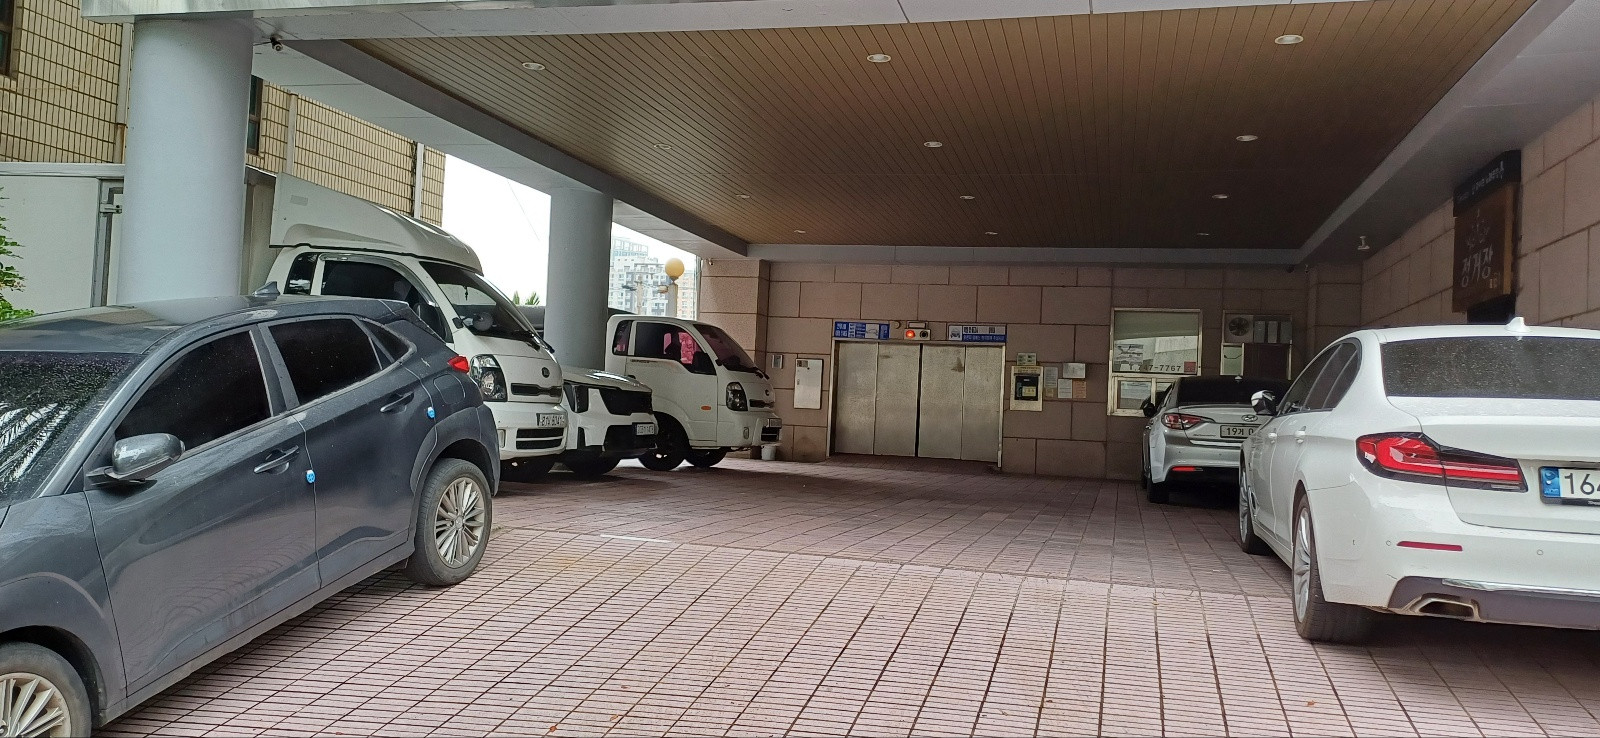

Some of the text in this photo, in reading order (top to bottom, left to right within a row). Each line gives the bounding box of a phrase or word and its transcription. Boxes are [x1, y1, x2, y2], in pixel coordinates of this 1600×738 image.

[1461, 243, 1494, 288] 정거장
[1226, 427, 1244, 436] 19거
[1564, 472, 1600, 495] 16
